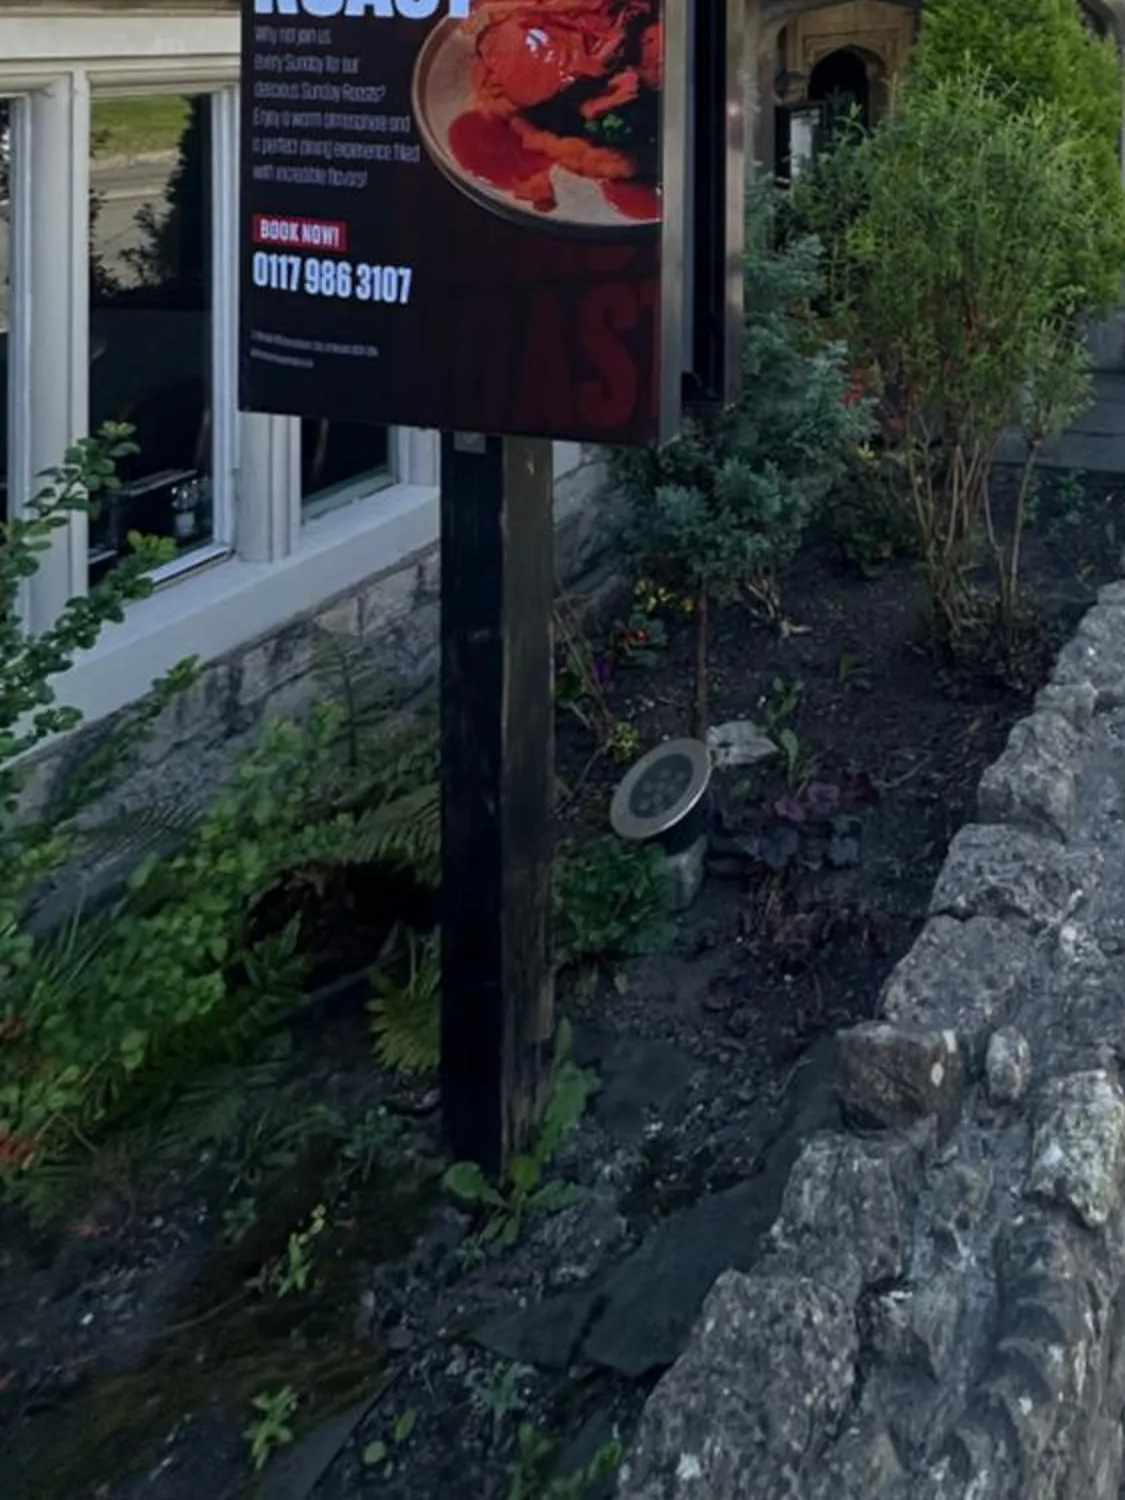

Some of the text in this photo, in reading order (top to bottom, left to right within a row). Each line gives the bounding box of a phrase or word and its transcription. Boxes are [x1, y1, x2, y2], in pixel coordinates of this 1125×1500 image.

[260, 219, 339, 248] BOOK NOW!
[253, 251, 412, 304] 0117 986 3107
